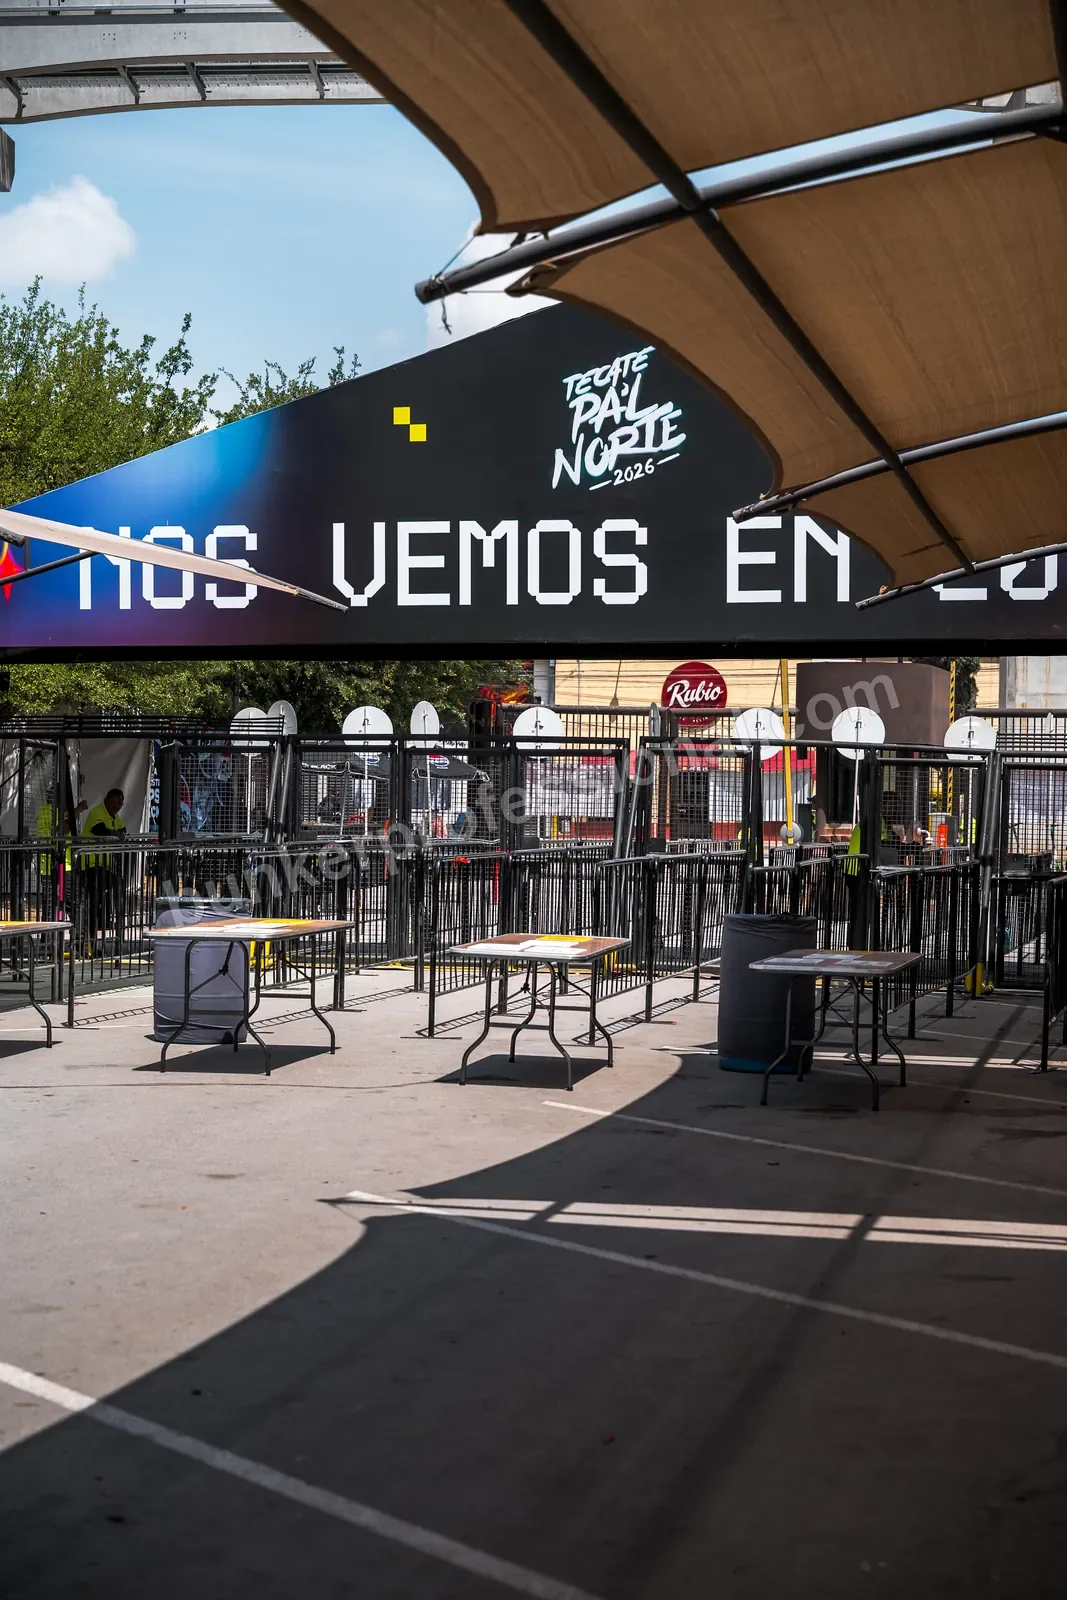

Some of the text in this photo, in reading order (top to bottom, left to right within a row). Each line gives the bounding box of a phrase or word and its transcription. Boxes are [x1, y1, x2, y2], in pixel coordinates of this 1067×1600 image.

[562, 345, 656, 401] TECATE
[551, 401, 687, 490] NORTE
[613, 458, 656, 487] 2026
[78, 523, 259, 610] NOS
[332, 518, 648, 607] VEMOS
[726, 515, 851, 604] EN
[666, 679, 724, 708] Rubio
